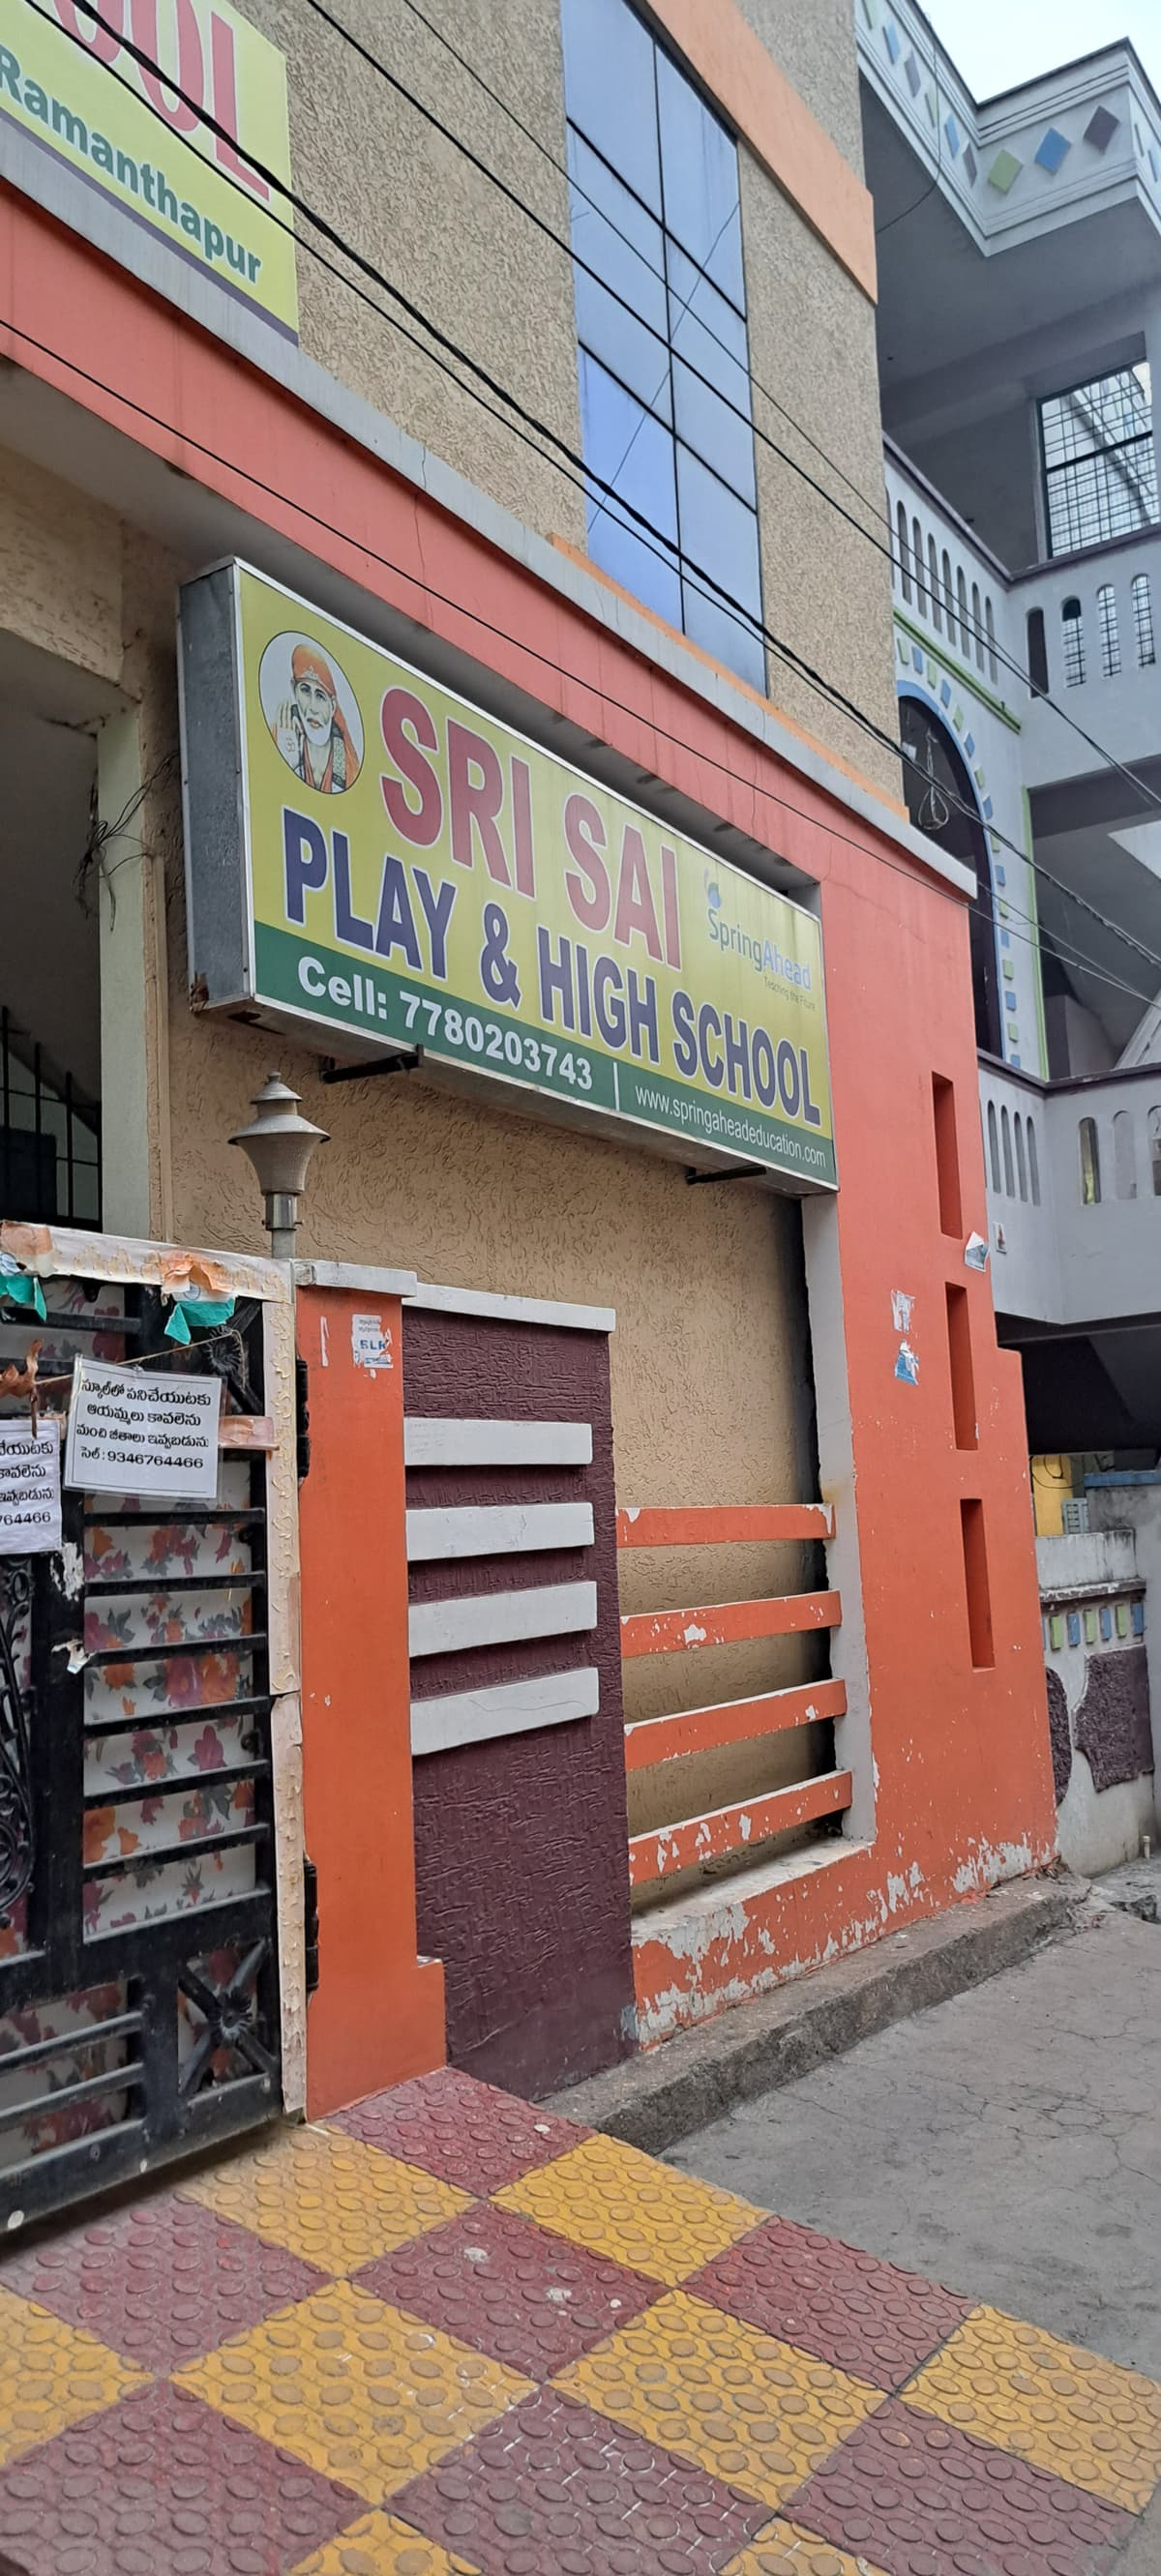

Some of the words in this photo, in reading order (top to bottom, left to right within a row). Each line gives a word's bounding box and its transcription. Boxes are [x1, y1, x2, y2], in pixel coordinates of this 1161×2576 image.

[0, 44, 262, 283] Ramanthapur
[381, 688, 536, 900] SRI
[564, 793, 681, 971] SAI
[283, 806, 458, 981] PLAY
[480, 903, 522, 1010] &
[537, 925, 661, 1065] HIGH
[671, 990, 822, 1128] SCHOOL
[707, 908, 811, 991] SpringAhead
[298, 956, 387, 1021] Cell:
[400, 990, 593, 1091] 7780203743
[635, 1084, 827, 1168] www.springaheadeducation.com
[107, 1450, 203, 1468] 9346764466
